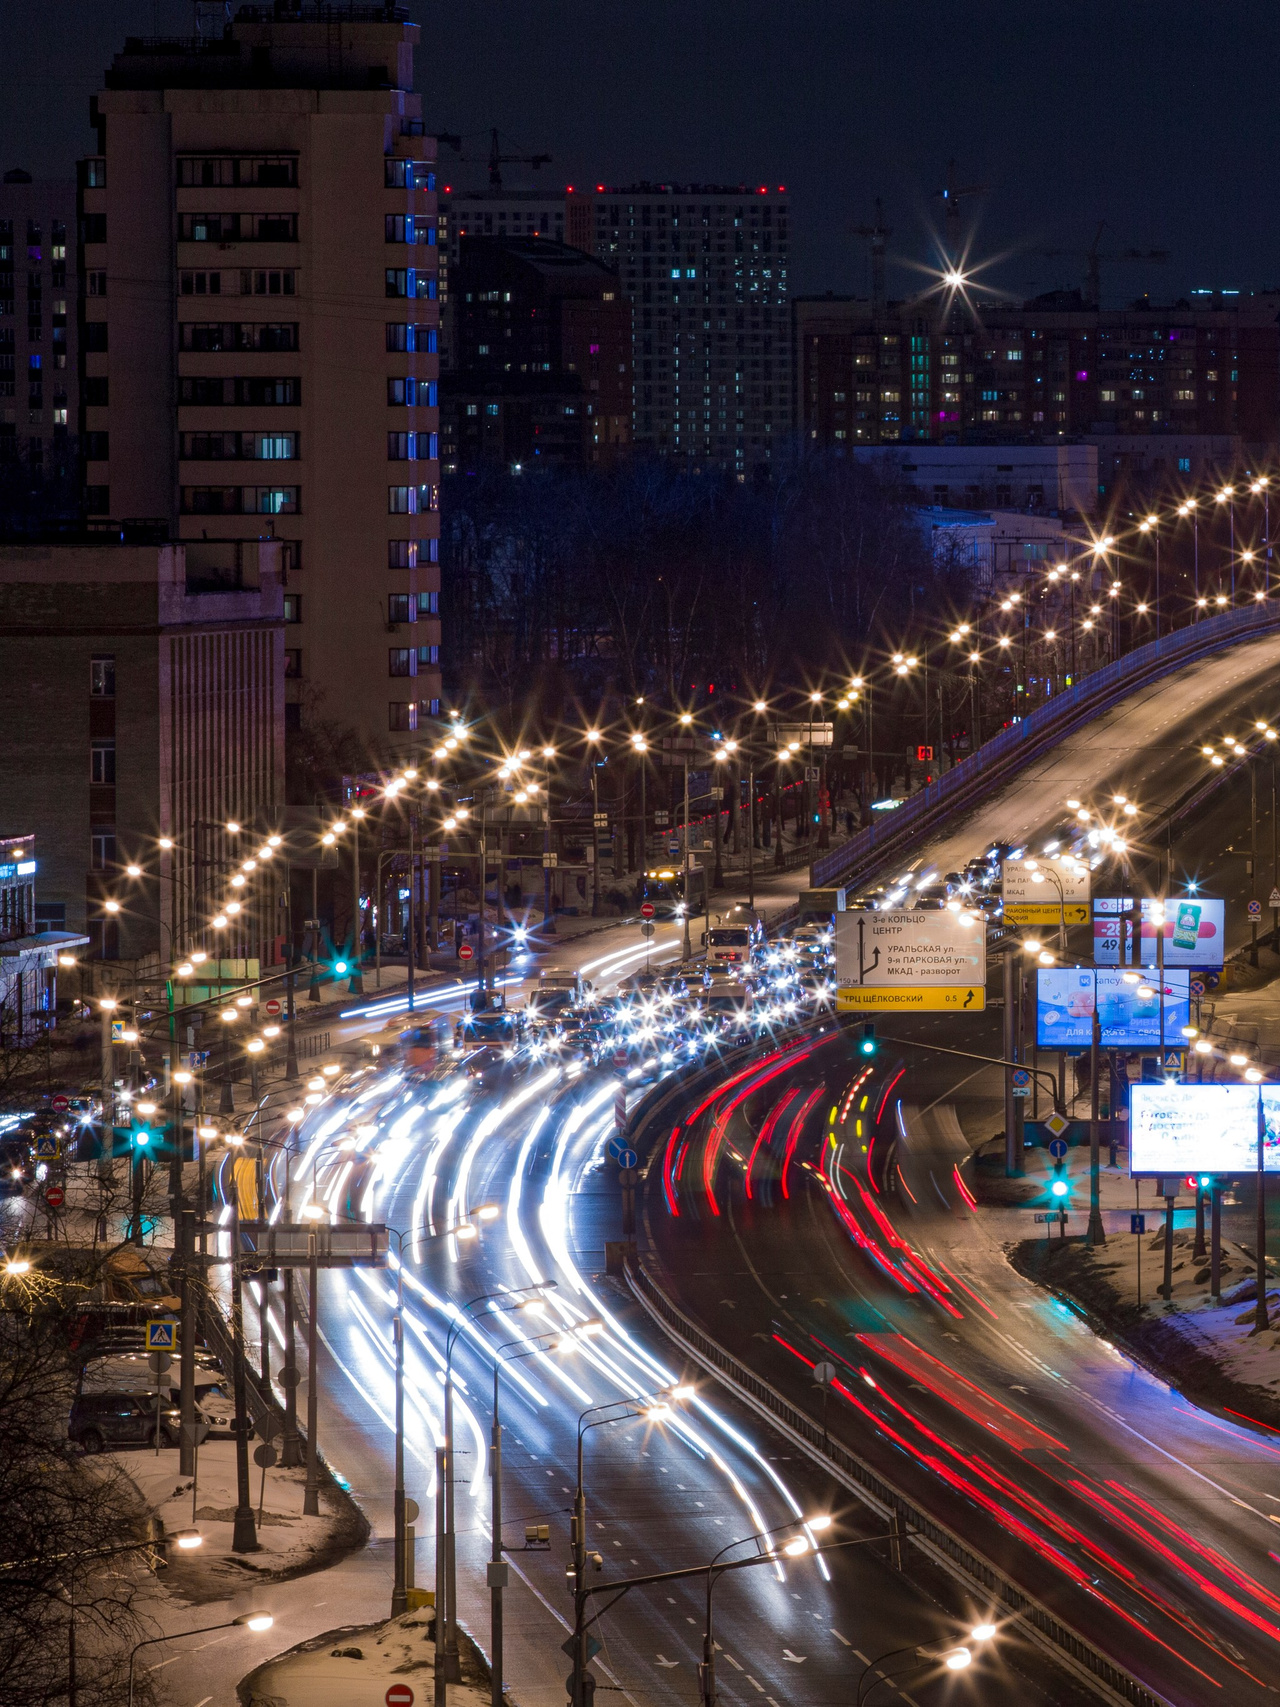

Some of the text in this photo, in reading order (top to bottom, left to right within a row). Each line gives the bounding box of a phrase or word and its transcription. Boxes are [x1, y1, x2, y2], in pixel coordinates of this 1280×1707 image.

[872, 915, 926, 924] 3-е КОЛЬЦО
[872, 927, 903, 935] ЦЕНТР
[887, 945, 956, 955] УРАЛЬСКАЯ ул.
[887, 956, 901, 964] 9-я
[903, 956, 952, 964] ПАРКОВАЯ
[887, 967, 913, 975] МКАД
[920, 968, 961, 977] разворот
[844, 995, 861, 1004] ТРЦ
[863, 993, 923, 1004] ЩЁЛКОВСКИЙ
[1066, 1029, 1084, 1037] ДЛЯ
